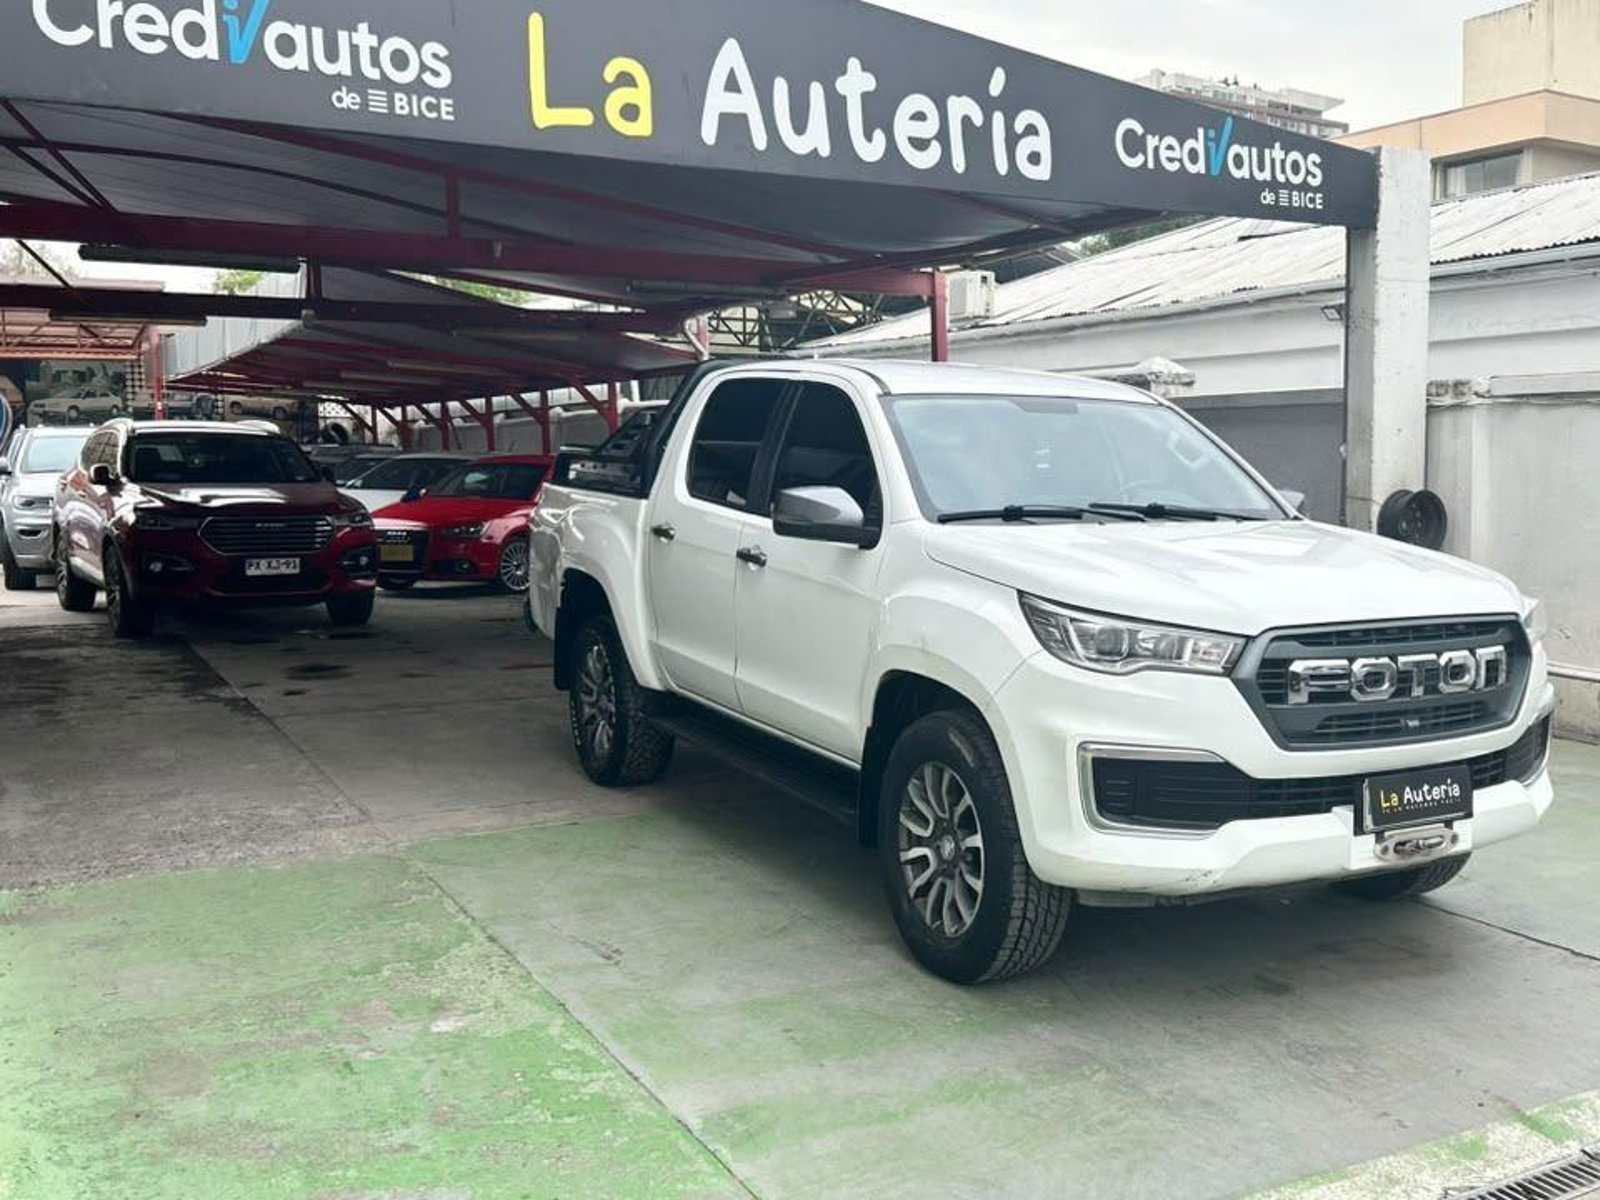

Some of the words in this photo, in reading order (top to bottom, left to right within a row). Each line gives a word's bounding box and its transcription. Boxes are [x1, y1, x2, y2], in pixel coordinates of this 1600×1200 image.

[331, 86, 361, 110] de
[394, 93, 455, 120] BICE
[528, 12, 653, 137] La
[701, 37, 1051, 181] Autería
[1260, 188, 1275, 206] de
[1291, 191, 1324, 209] BICE
[1287, 645, 1506, 704] FOTON
[1380, 790, 1399, 808] La
